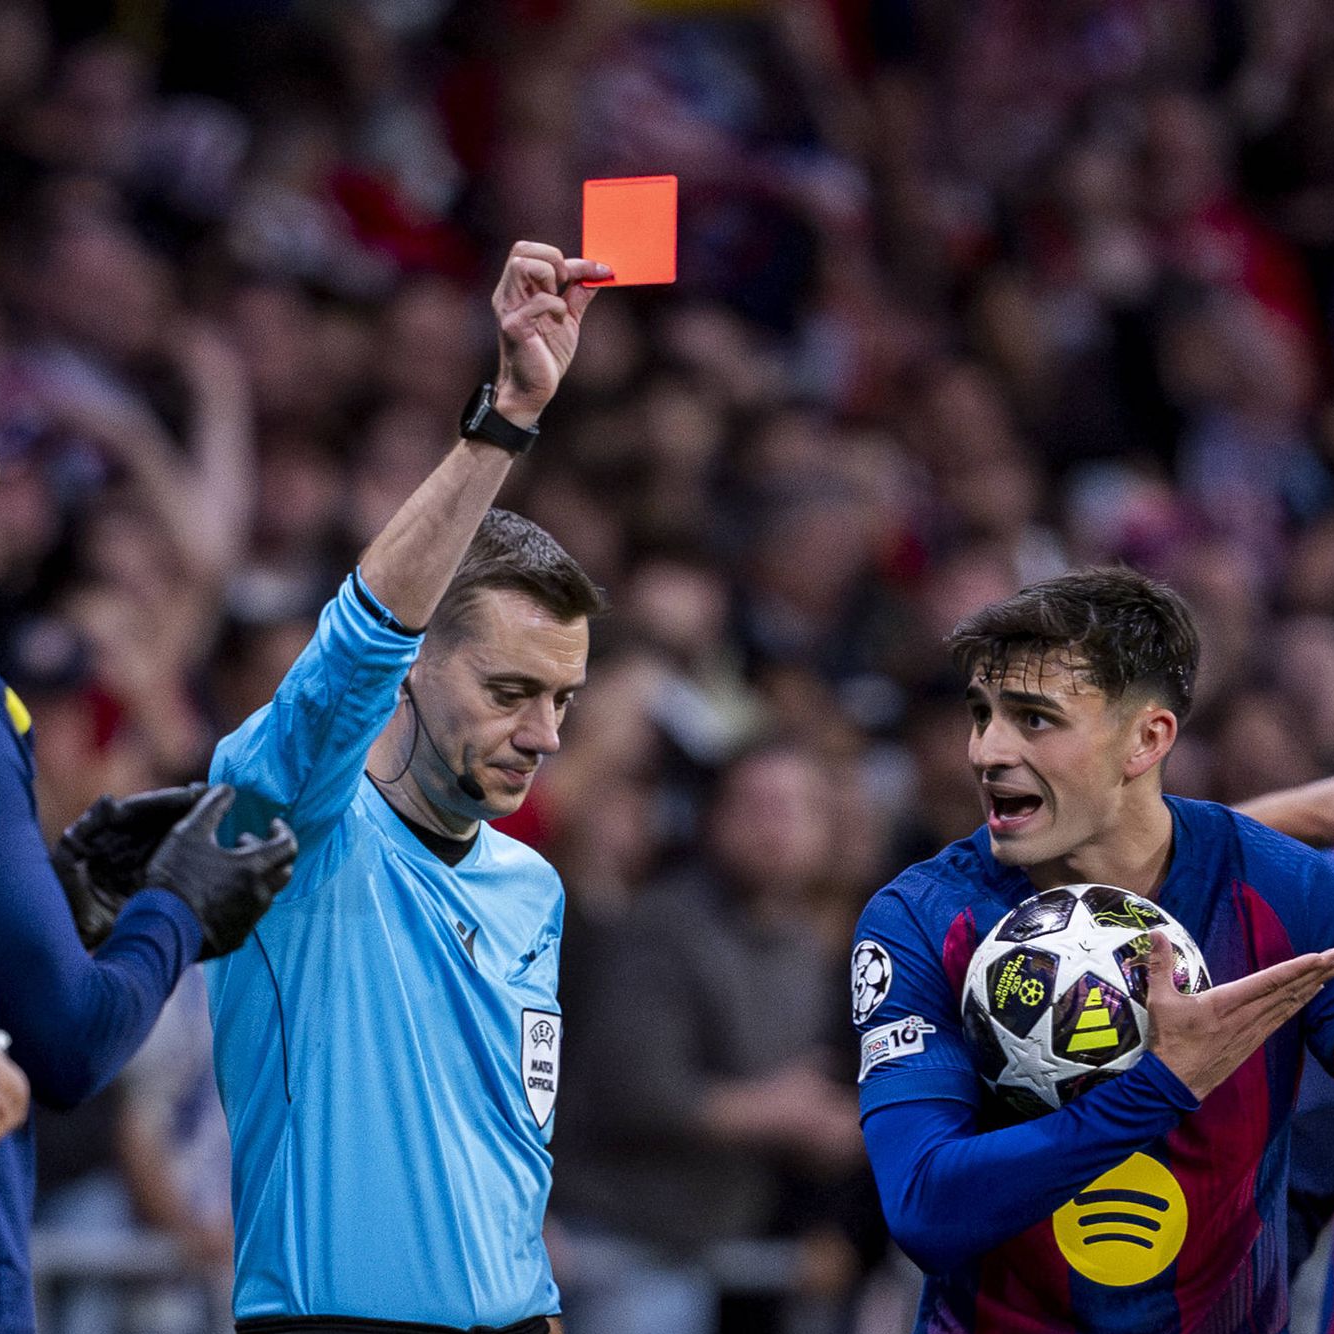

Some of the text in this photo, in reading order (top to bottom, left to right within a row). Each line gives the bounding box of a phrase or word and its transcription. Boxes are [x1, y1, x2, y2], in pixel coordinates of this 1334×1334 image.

[889, 1026, 919, 1048] 10
[531, 1059, 554, 1075] MATCH
[527, 1076, 555, 1093] OFFICIAL
